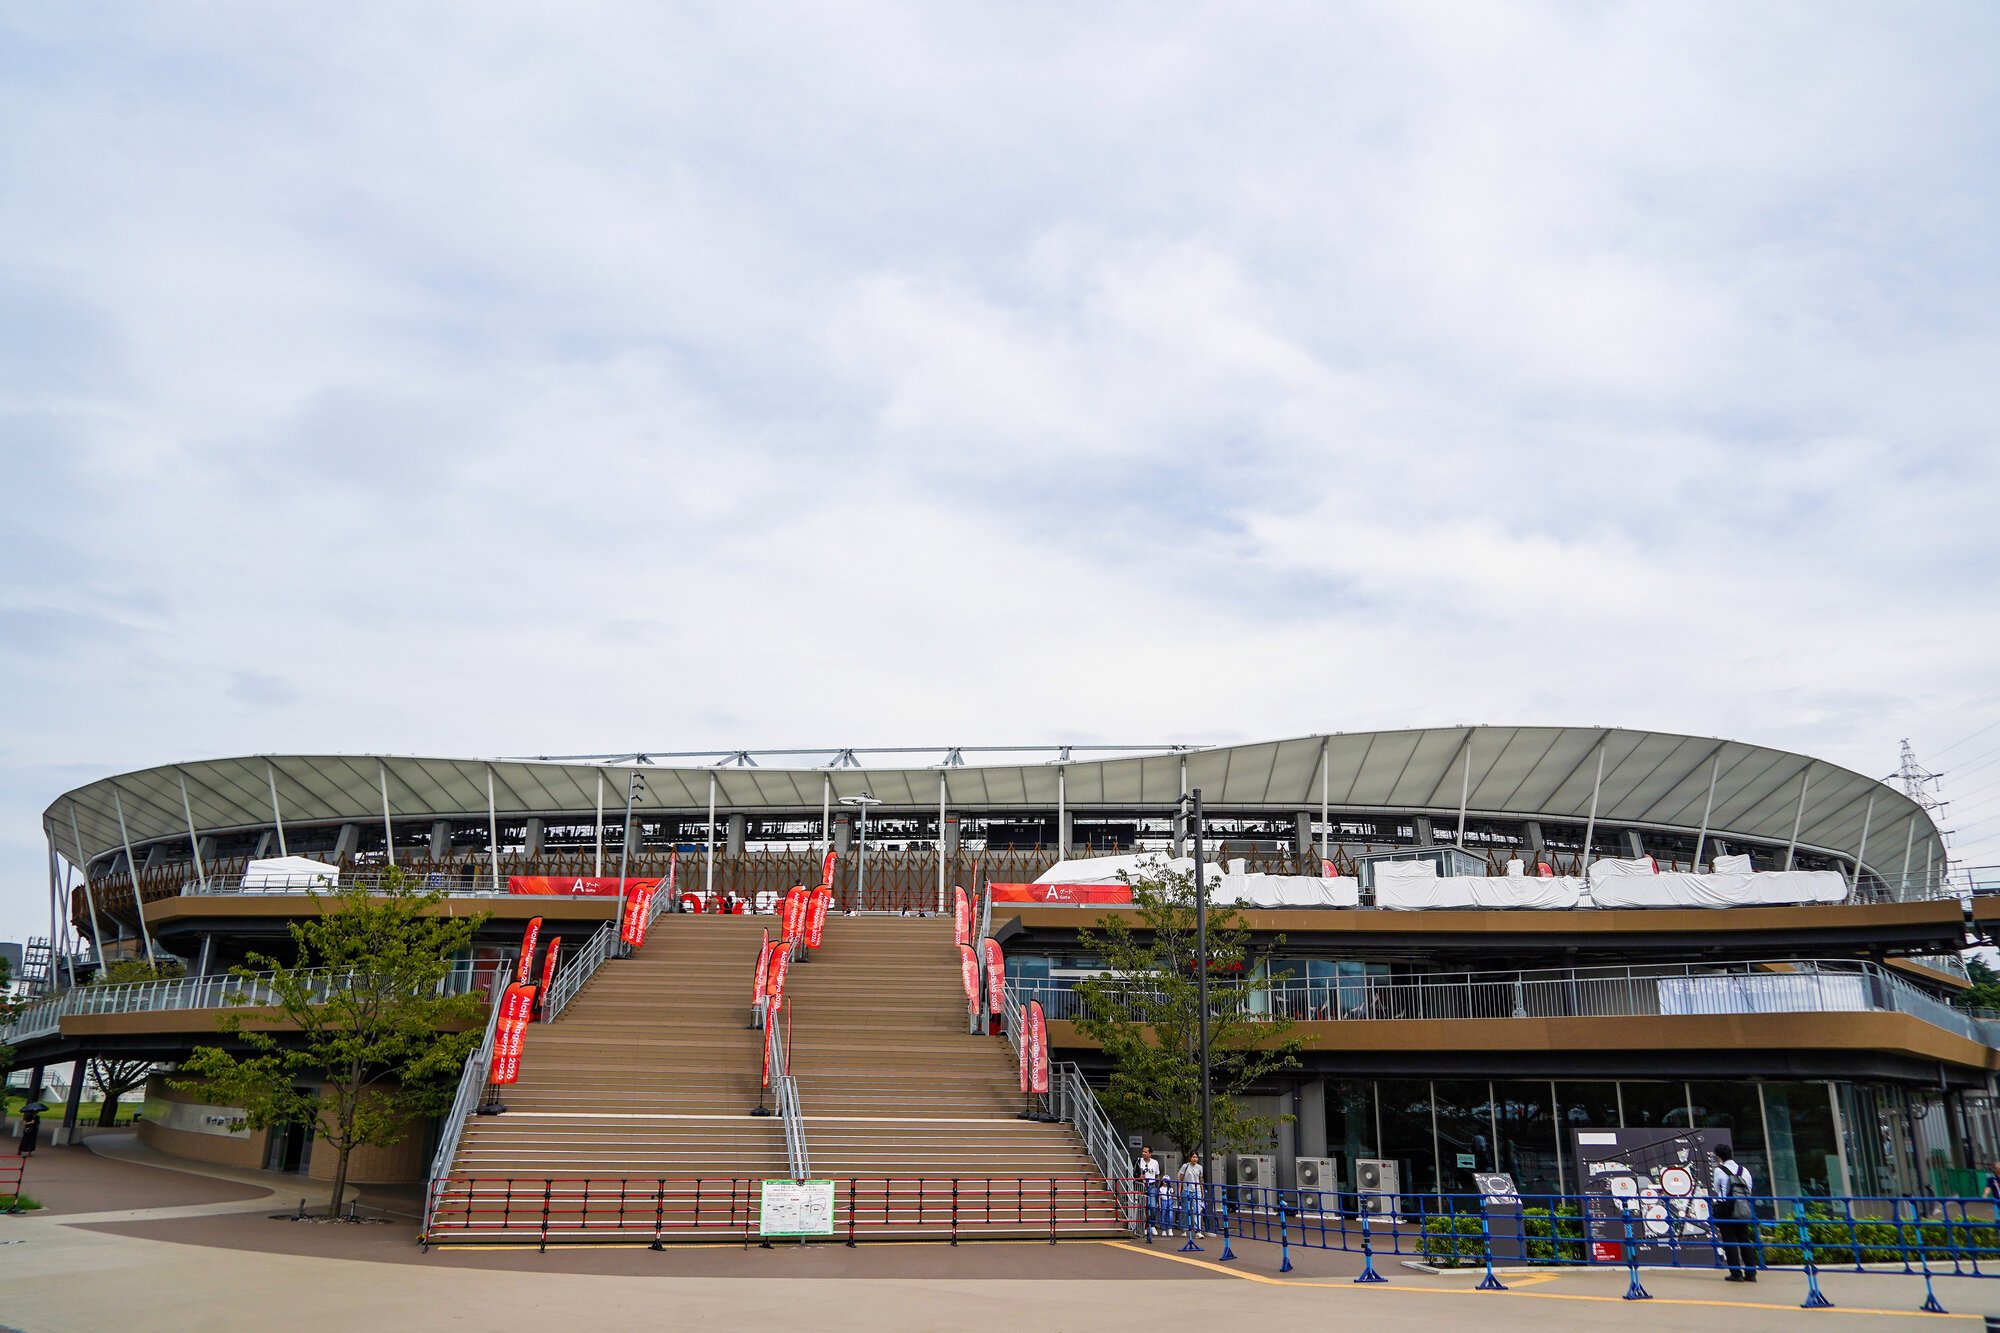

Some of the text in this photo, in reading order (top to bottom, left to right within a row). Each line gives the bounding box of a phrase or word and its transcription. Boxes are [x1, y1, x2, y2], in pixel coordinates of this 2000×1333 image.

[572, 878, 584, 892] A
[1046, 884, 1058, 900] A
[776, 951, 787, 992] Aichi-Nagoya
[501, 993, 516, 1055] Aichi-Nagoya
[506, 996, 530, 1080] Aichi-Nagoya 2026
